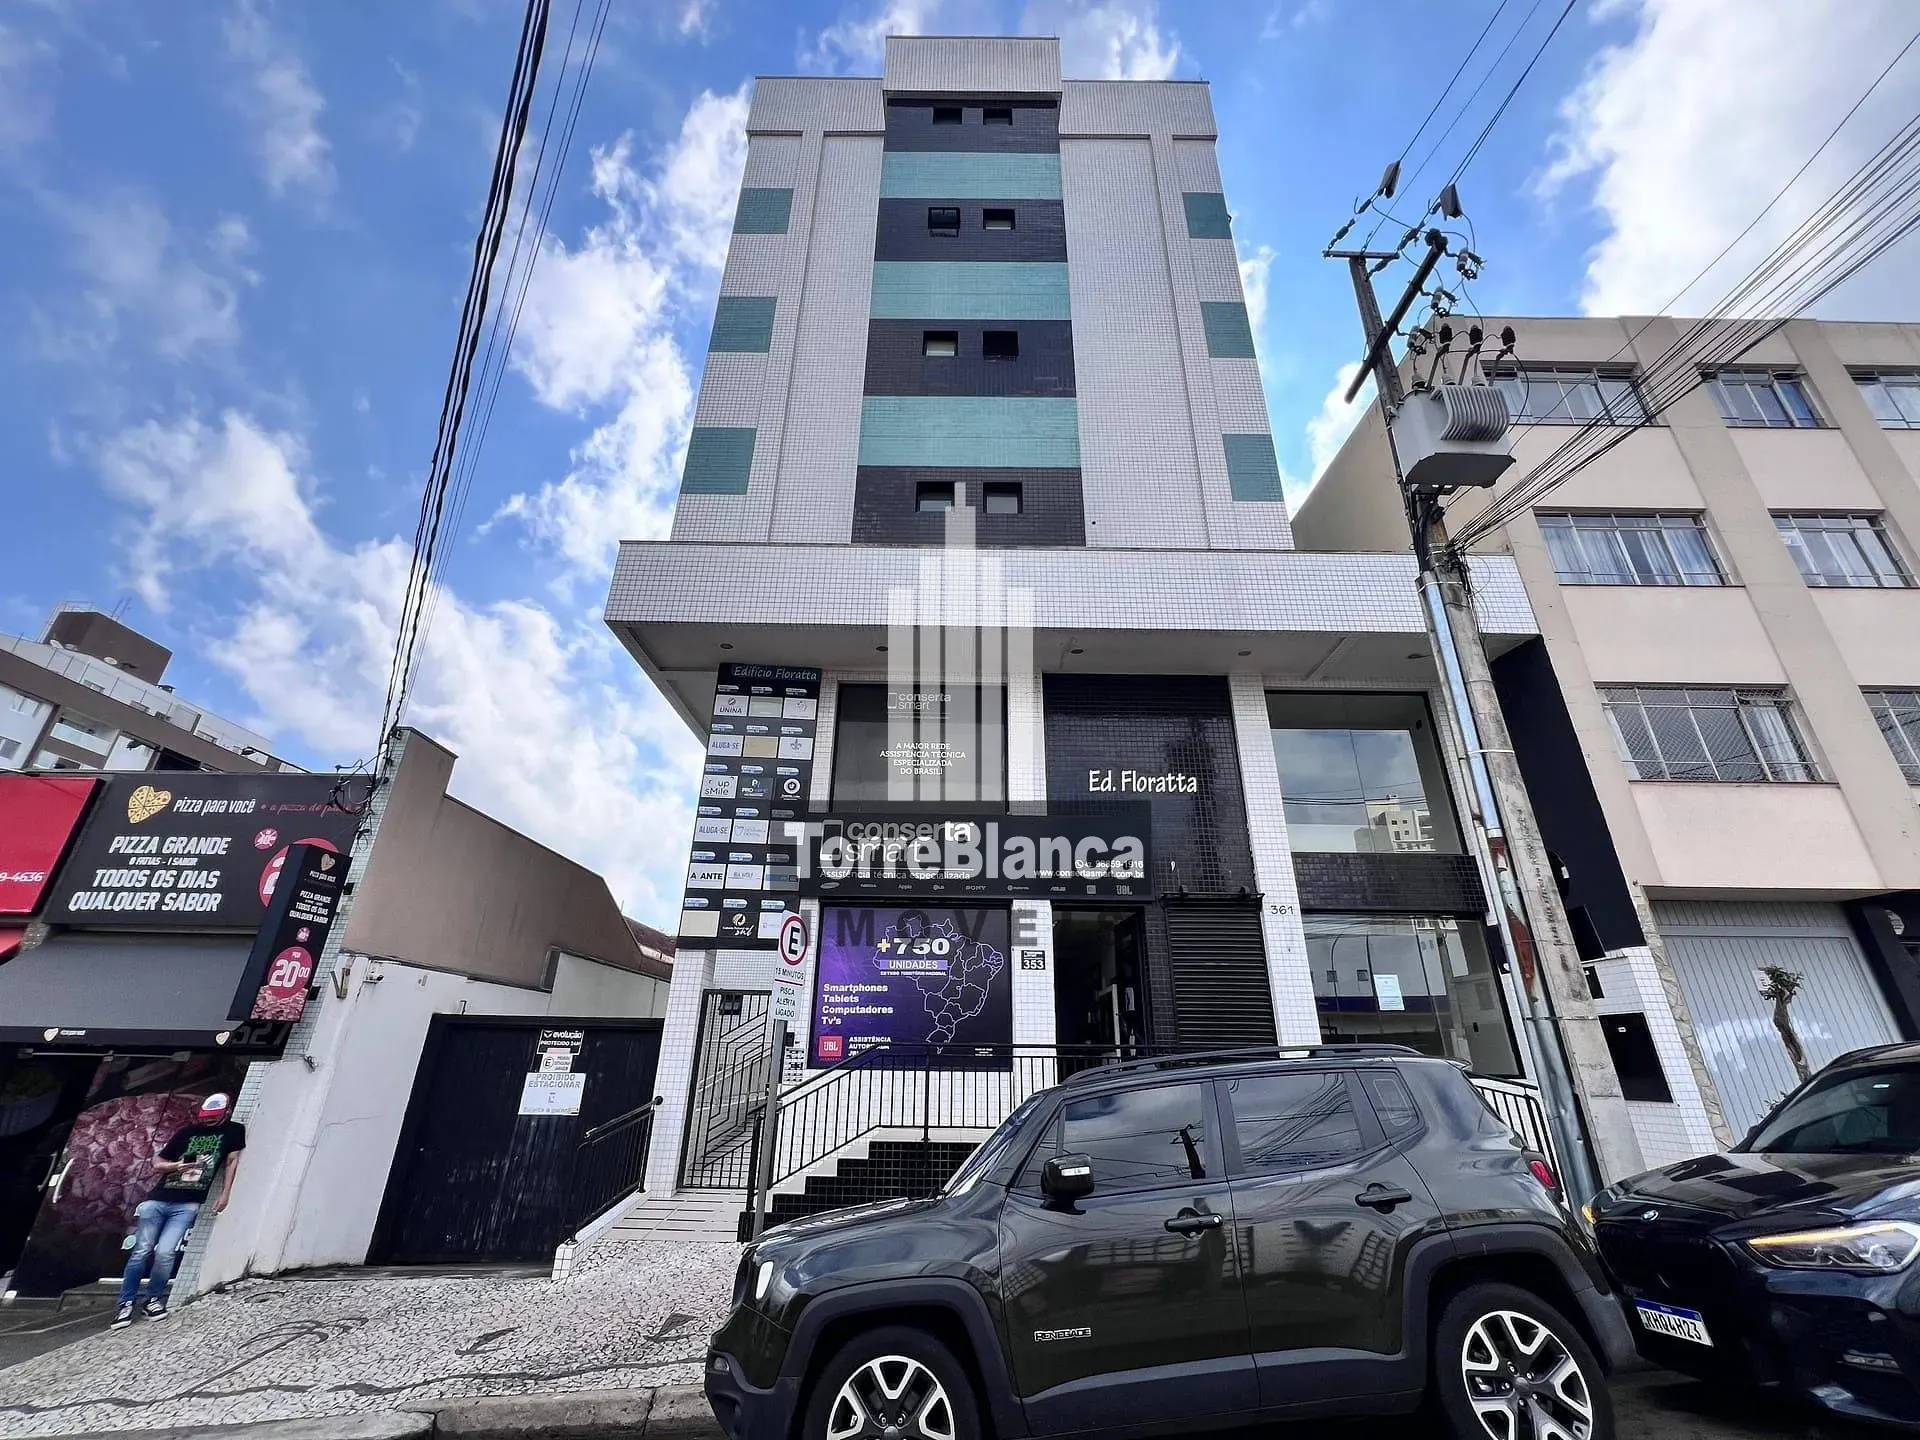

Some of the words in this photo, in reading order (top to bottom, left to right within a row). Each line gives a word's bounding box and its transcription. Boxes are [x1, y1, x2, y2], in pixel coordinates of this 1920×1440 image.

[775, 668, 818, 680] Floratta
[898, 692, 952, 702] conserta
[711, 740, 740, 750] ALUGA-SE
[903, 742, 930, 750] MAIOR
[879, 749, 930, 758] ASSISTÊNCIA
[893, 759, 953, 767] ESPECIALIZADA
[900, 767, 913, 775] DO
[1088, 769, 1116, 792] Ed.
[1121, 769, 1198, 793] Floratta
[200, 799, 227, 816] para
[228, 798, 257, 813] você
[699, 825, 728, 834] ALUGA-SE
[847, 821, 973, 841] conserta
[108, 836, 160, 854] PIZZA
[161, 836, 232, 855] GRANDE
[845, 840, 921, 862] smart
[92, 869, 150, 888] TODOS
[150, 869, 175, 888] OS
[176, 870, 221, 889] DIAS
[819, 869, 871, 879] Assistência
[873, 870, 907, 879] técnica
[909, 869, 971, 881] especializada
[68, 891, 161, 912] QUALQUER
[161, 892, 223, 912] SABOR
[1270, 905, 1294, 915] 361
[788, 926, 800, 956] E
[889, 960, 938, 969] UNIDADES
[1023, 959, 1044, 969] 353
[780, 986, 795, 996] PISCA
[823, 983, 888, 993] Smartphones
[776, 997, 796, 1007] ALERTA
[822, 994, 860, 1003] Tablets
[775, 1008, 795, 1018] LIGADO
[822, 1005, 894, 1015] Computadores
[821, 1016, 842, 1026] Tv's
[552, 1030, 582, 1039] evolução
[848, 1035, 892, 1043] ASSISTÊNCIA
[823, 1041, 838, 1051] JBL
[536, 1073, 576, 1081] PROIBIDO
[528, 1080, 581, 1089] ESTACIONAR
[1034, 1327, 1092, 1342] RENEGADE
